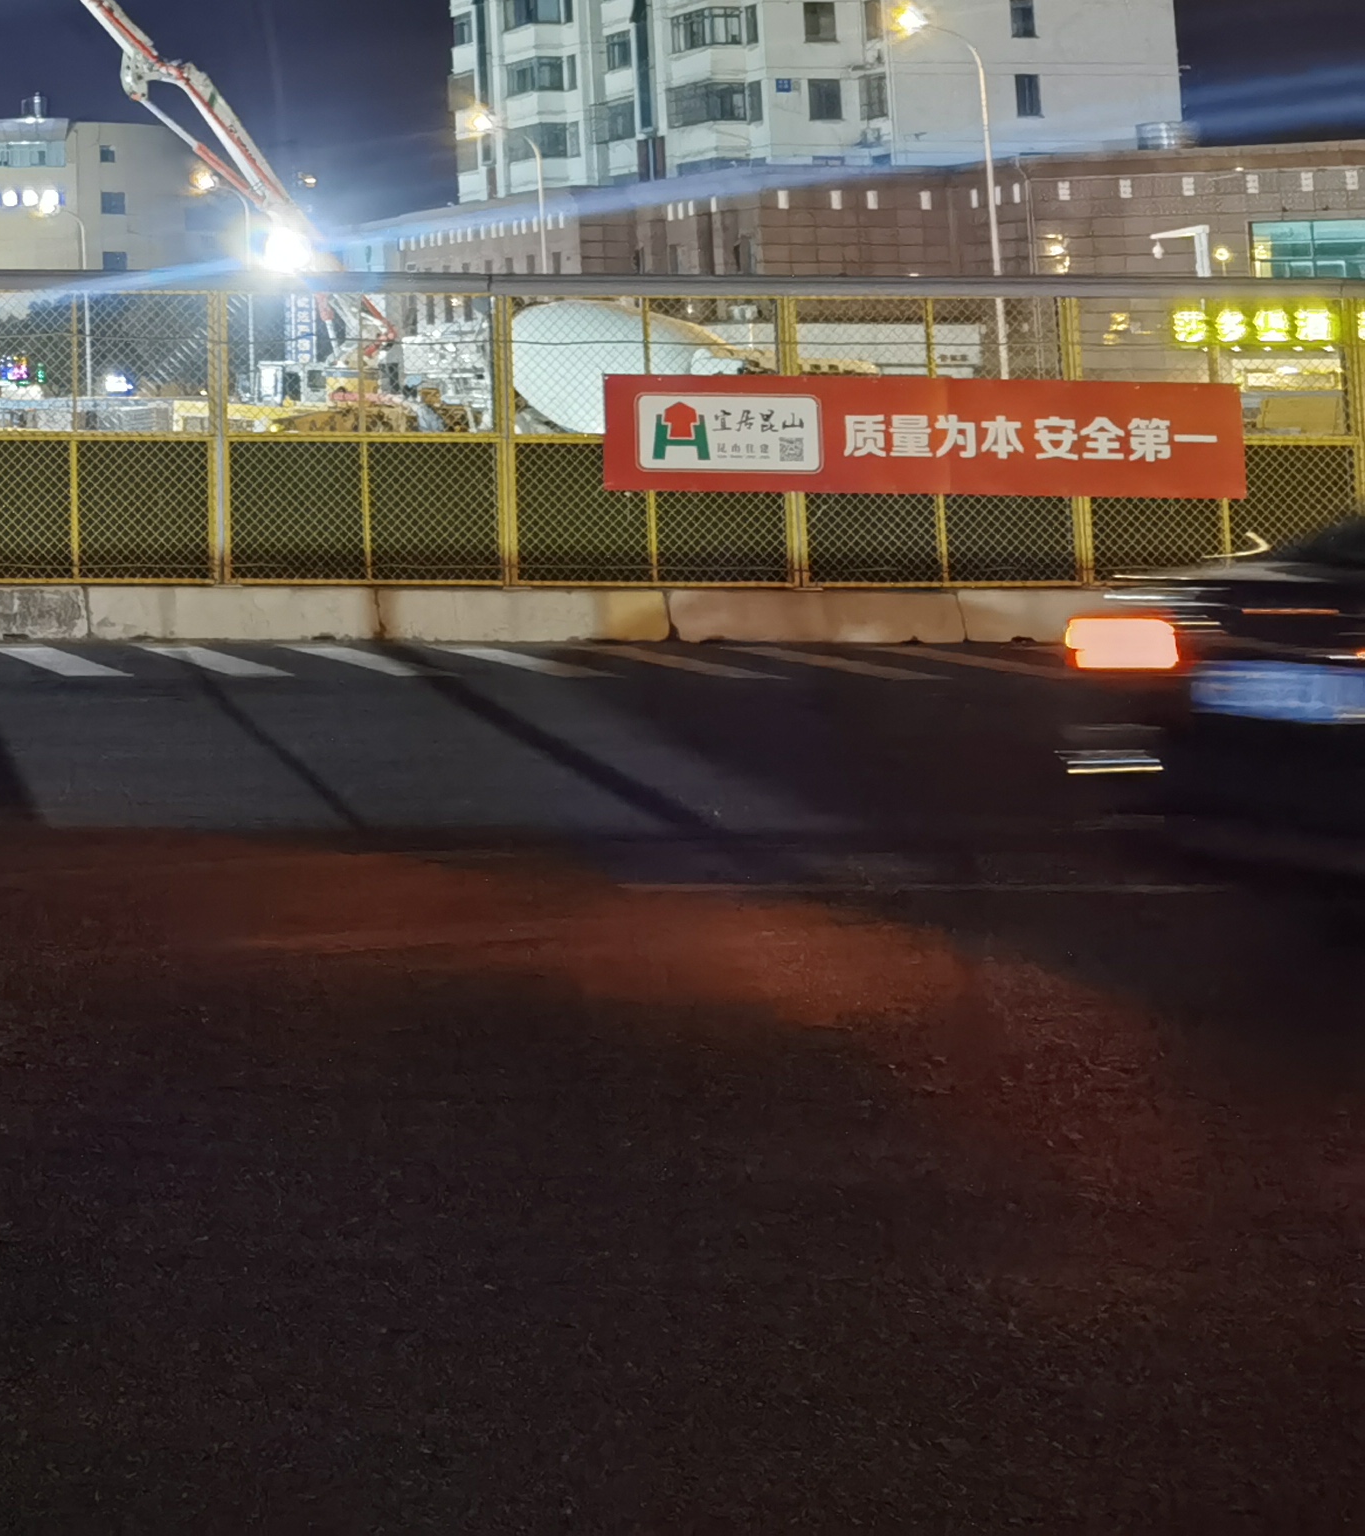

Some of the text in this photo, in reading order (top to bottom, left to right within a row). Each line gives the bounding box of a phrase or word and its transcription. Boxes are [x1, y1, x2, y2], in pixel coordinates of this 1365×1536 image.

[712, 409, 805, 433] 宜居昆山
[843, 414, 1218, 462] 质量为本 安全第一
